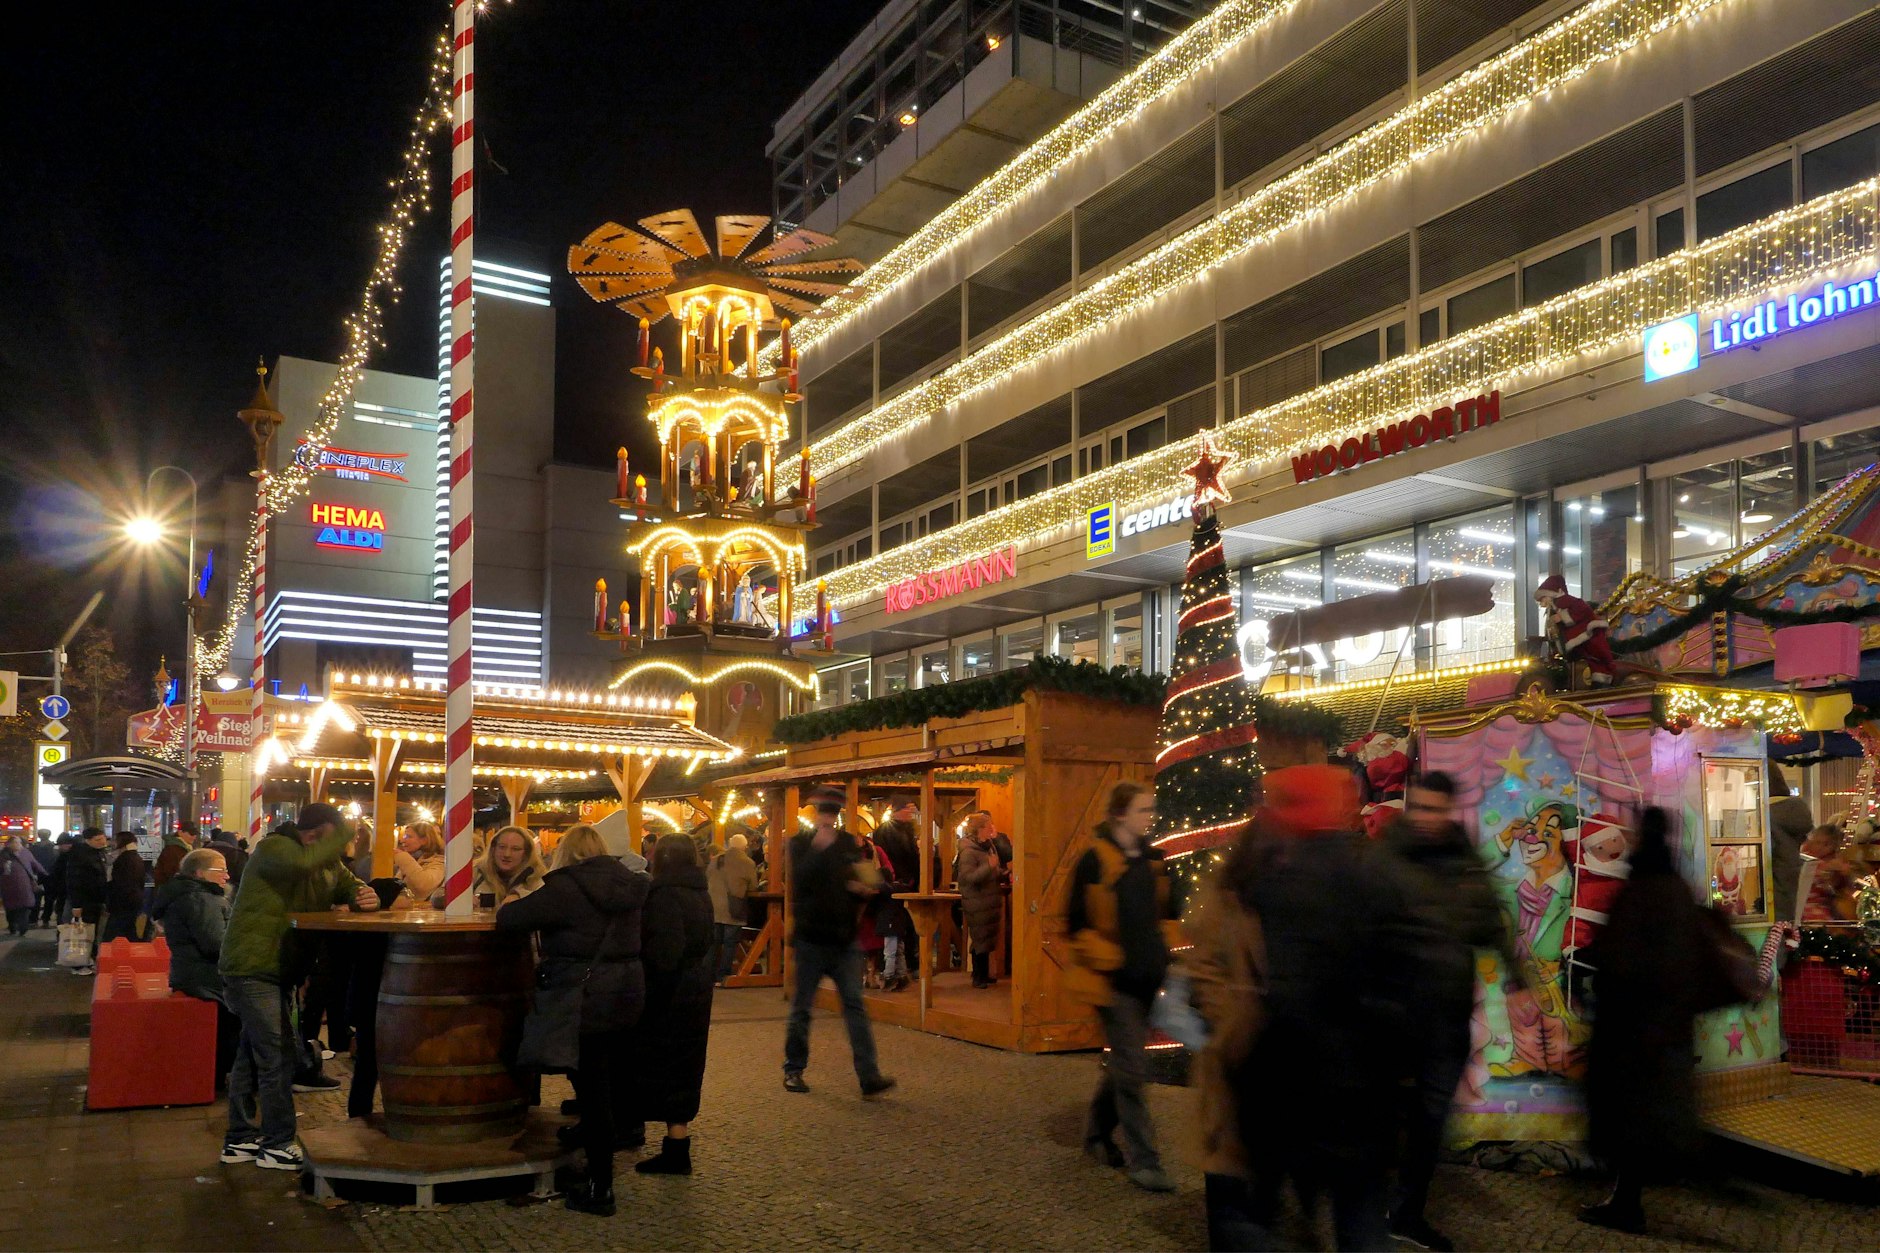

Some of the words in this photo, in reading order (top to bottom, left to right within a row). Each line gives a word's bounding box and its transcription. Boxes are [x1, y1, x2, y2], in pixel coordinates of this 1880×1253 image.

[1713, 301, 1778, 350] Lidl
[1291, 389, 1500, 484] WOOLWORTH
[296, 443, 406, 474] CINEPLEX
[312, 503, 386, 530] HEMA
[1121, 494, 1195, 537] cente
[316, 527, 384, 549] ALDI
[1089, 542, 1111, 554] EDEKA
[885, 544, 1016, 614] ROSSMANN
